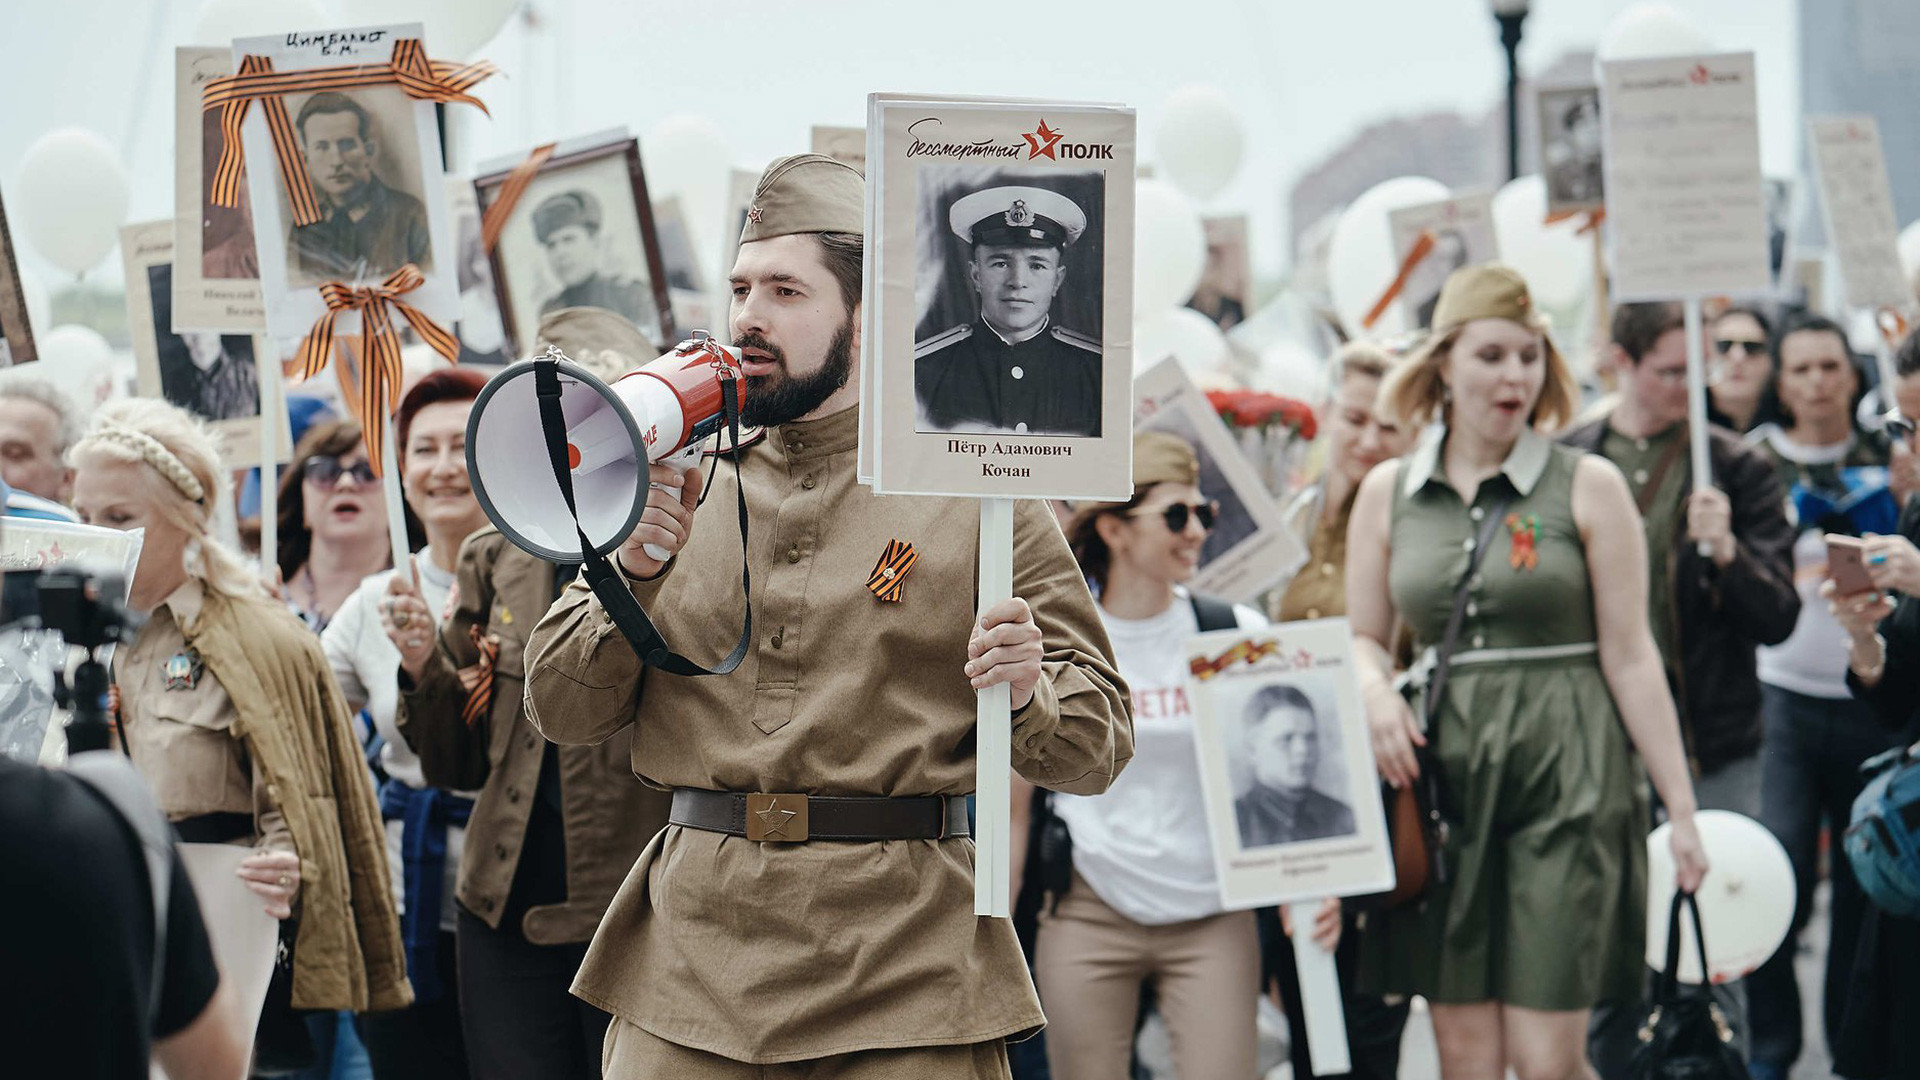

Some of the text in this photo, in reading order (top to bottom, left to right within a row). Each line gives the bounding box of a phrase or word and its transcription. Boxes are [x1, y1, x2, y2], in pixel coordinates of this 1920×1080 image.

[907, 117, 1113, 160] бессмертный ПОЛК
[947, 440, 1072, 457] Пётр Адамович
[982, 463, 1031, 477] Кочан
